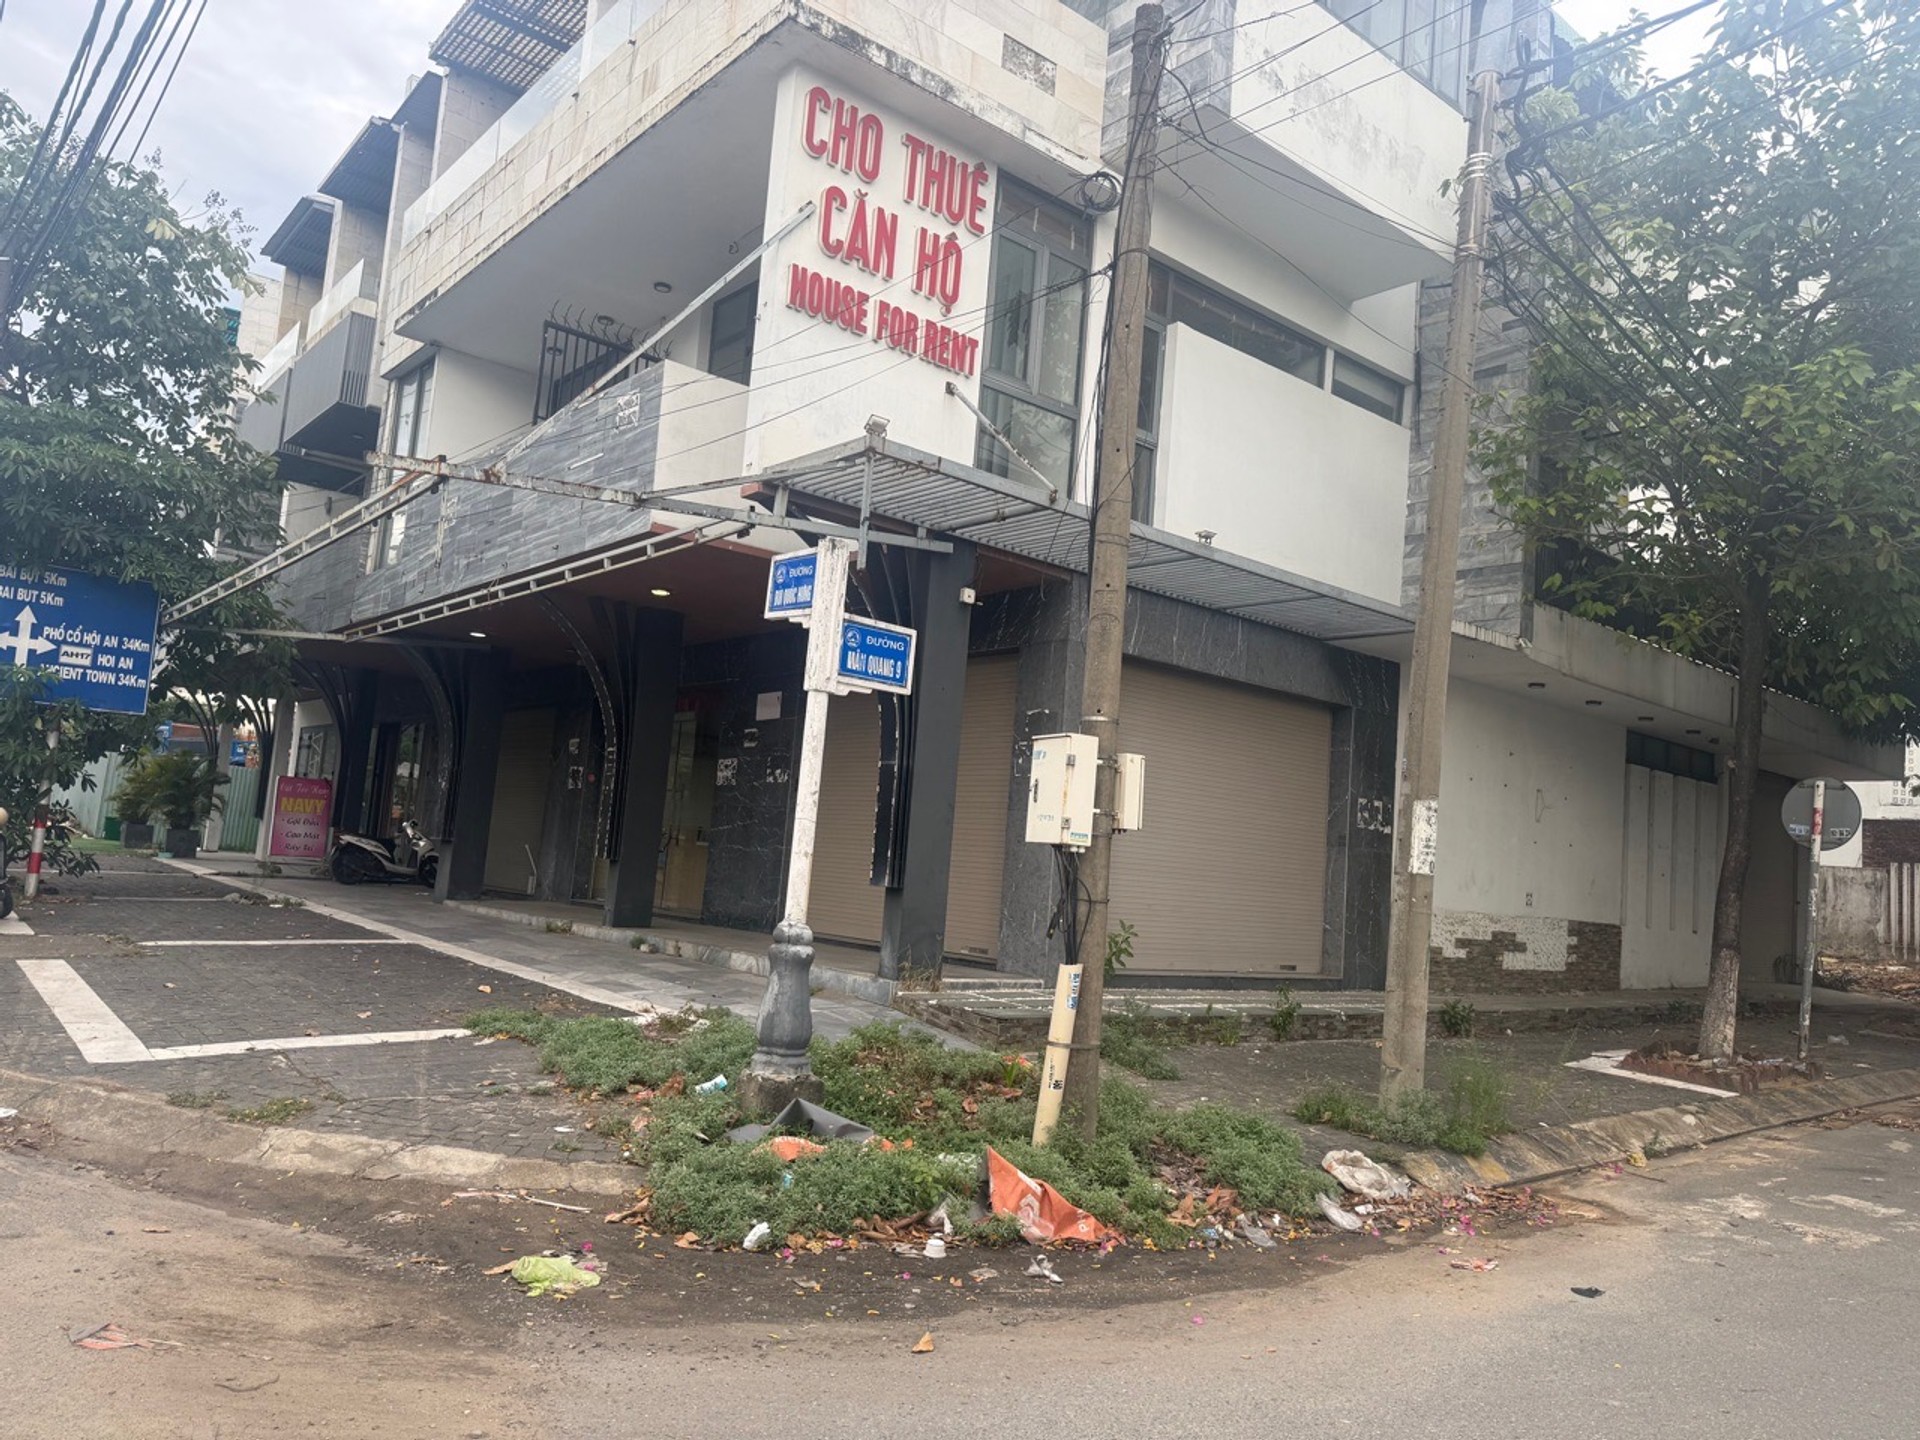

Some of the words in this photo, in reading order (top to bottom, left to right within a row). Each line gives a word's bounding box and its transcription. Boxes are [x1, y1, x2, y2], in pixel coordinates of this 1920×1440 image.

[803, 86, 883, 183] CHO
[902, 132, 989, 237] THUÊ
[818, 186, 898, 281] CĂN
[912, 226, 963, 317] HỘ
[786, 263, 870, 336] HOUSE
[872, 299, 920, 358] FOR
[919, 319, 980, 378] RENT
[17, 588, 39, 602] BUT
[40, 591, 64, 607] 5Km
[43, 622, 65, 640] PHỐ
[83, 630, 102, 648] HỘI
[103, 635, 119, 648] AN
[121, 637, 151, 652] 34Km
[866, 636, 904, 651] ĐƯỜNG
[97, 654, 115, 668] HOI
[118, 656, 134, 670] AN
[895, 661, 902, 679] 9
[85, 669, 117, 685] TOWN
[117, 673, 147, 689] 34Km
[281, 797, 326, 815] NAVY
